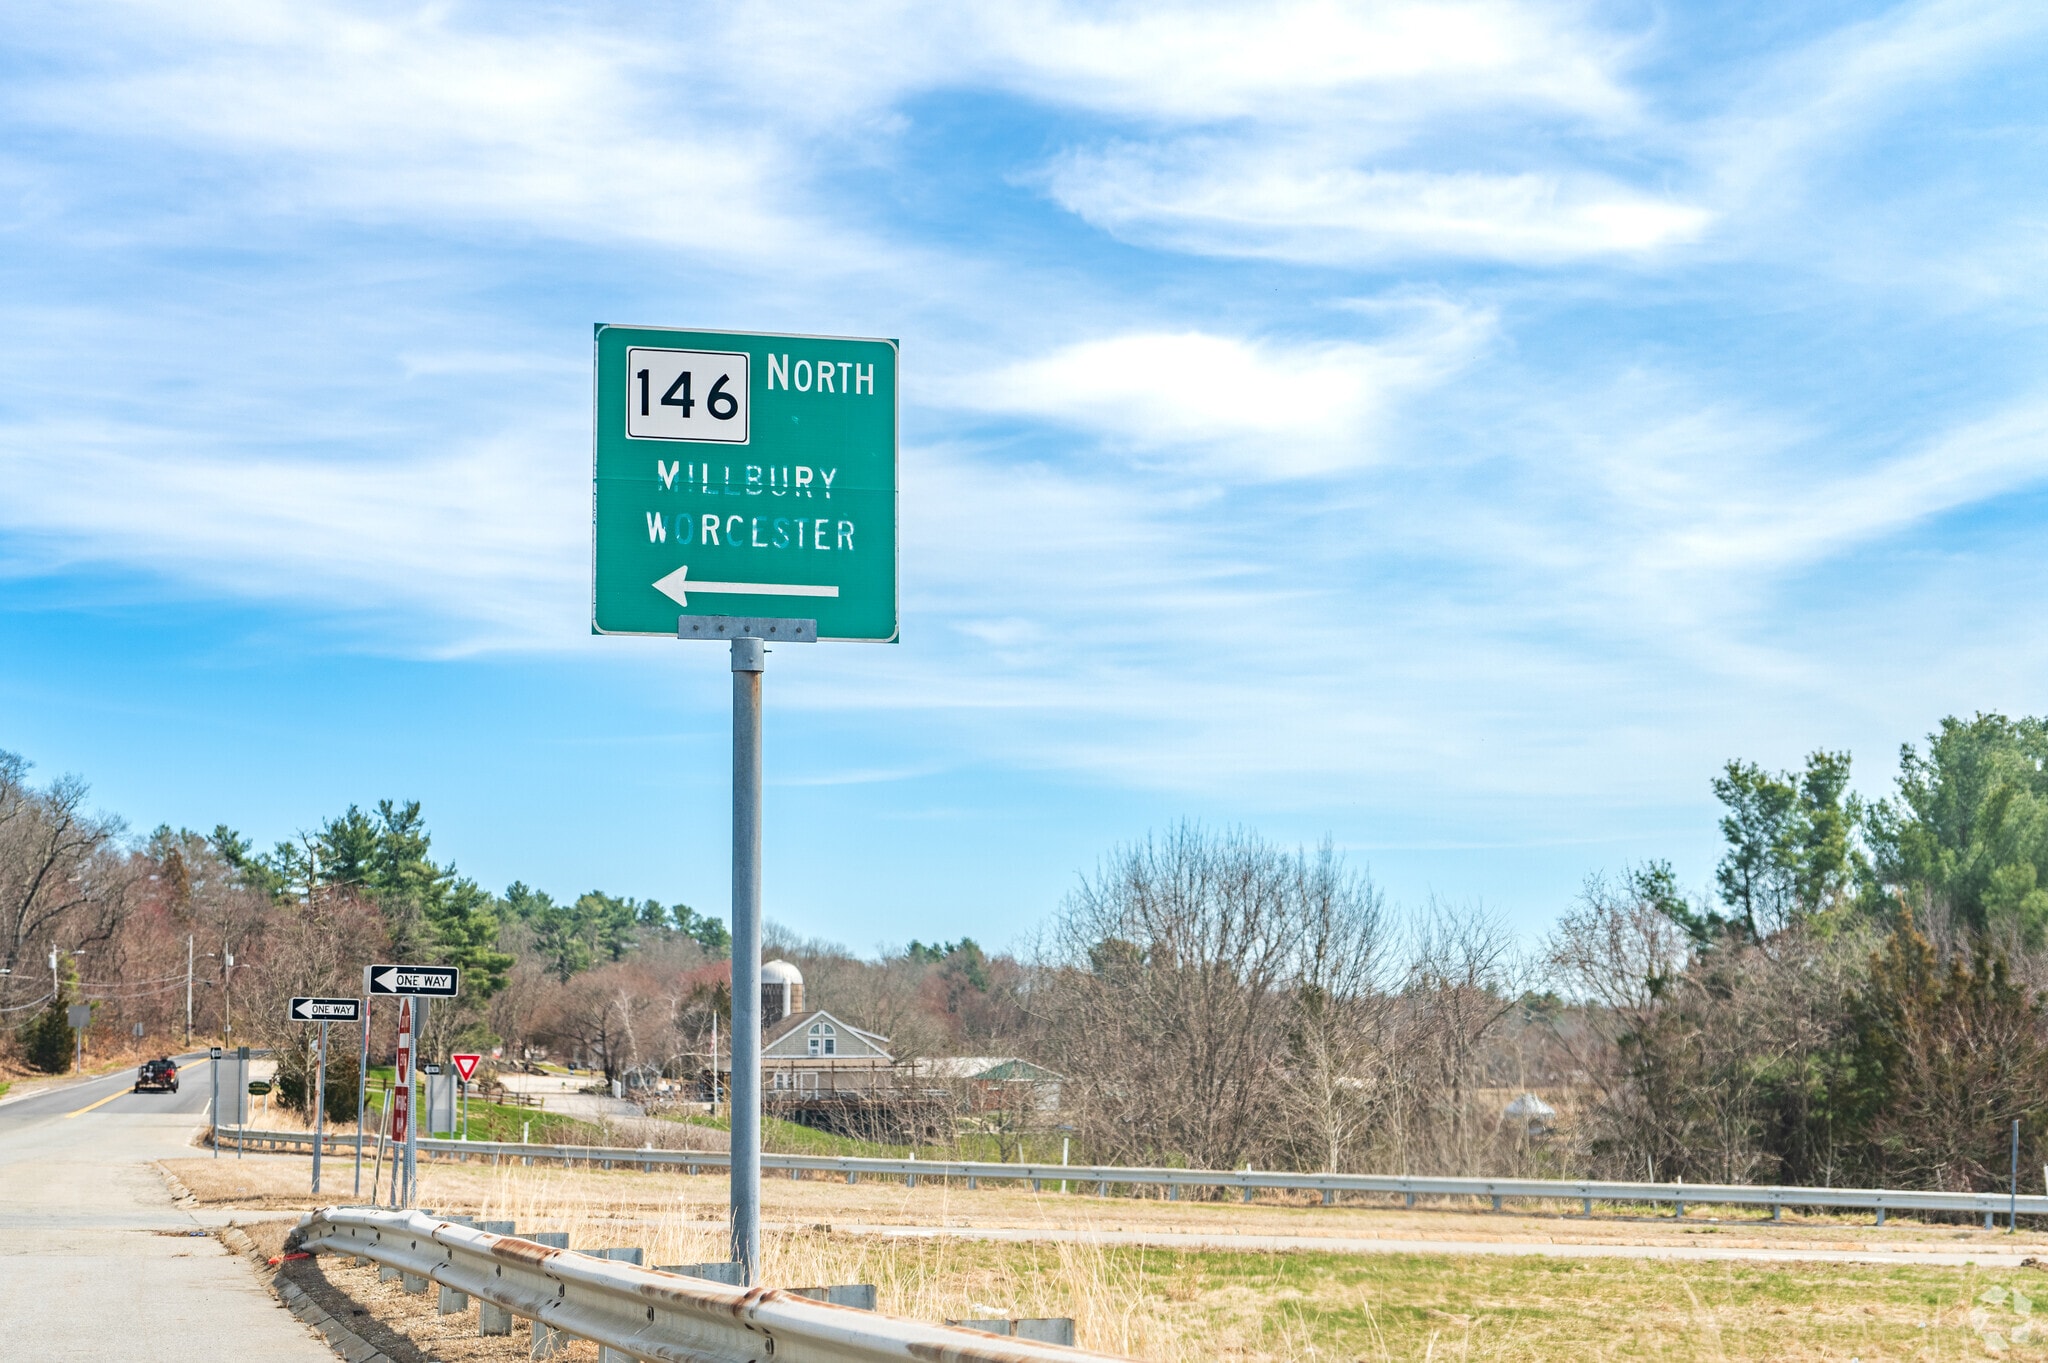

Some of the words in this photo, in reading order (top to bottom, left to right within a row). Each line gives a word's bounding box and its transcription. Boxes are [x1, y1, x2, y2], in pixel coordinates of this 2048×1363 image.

[767, 353, 874, 396] NORTH
[637, 369, 738, 420] 146
[657, 460, 837, 499] MILLBURY
[646, 511, 855, 551] WORCESTER
[396, 974, 419, 986] ONE
[424, 975, 448, 987] WAY
[312, 1004, 331, 1014] ONE
[333, 1005, 352, 1015] WAY
